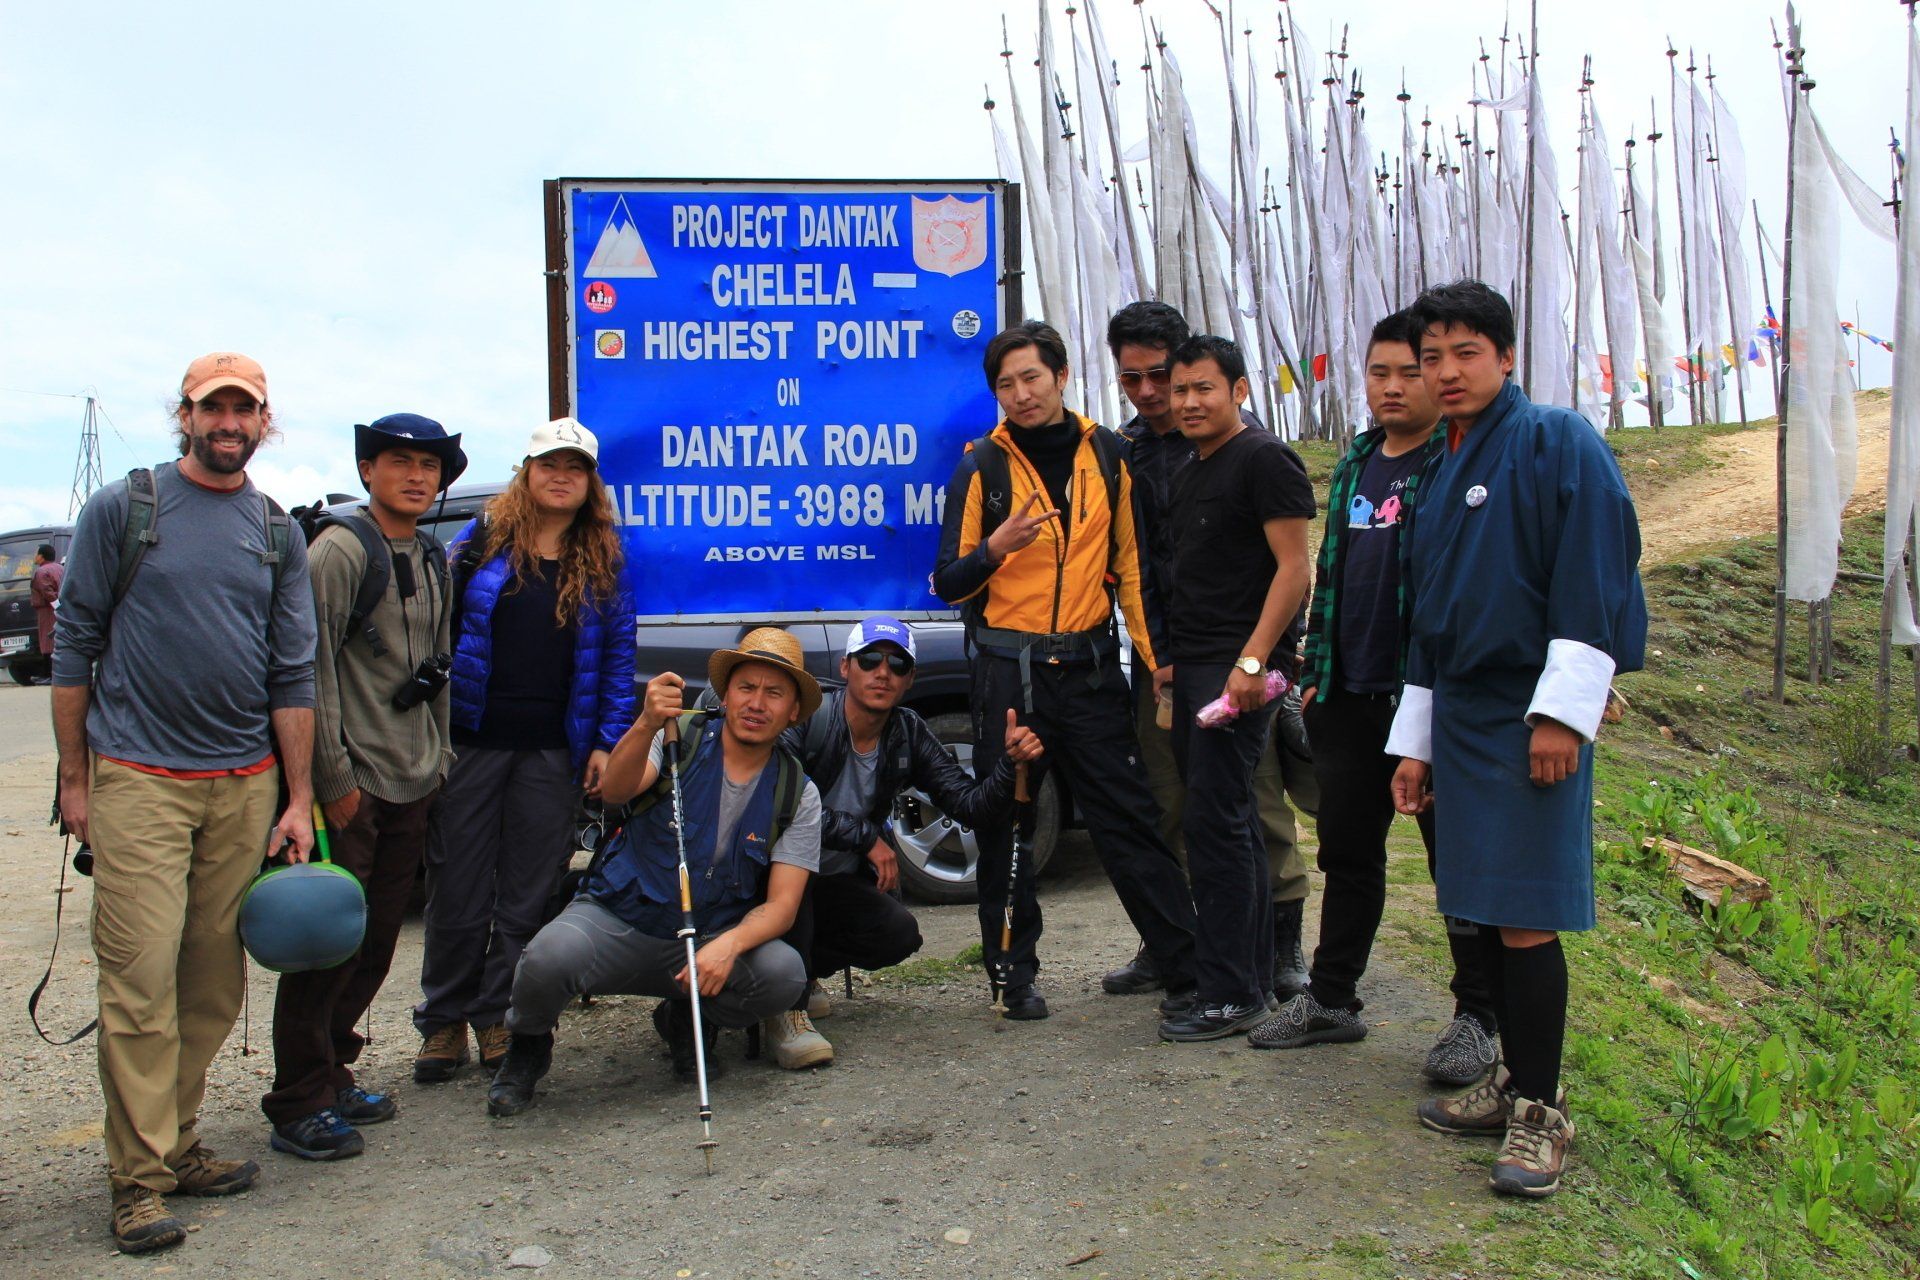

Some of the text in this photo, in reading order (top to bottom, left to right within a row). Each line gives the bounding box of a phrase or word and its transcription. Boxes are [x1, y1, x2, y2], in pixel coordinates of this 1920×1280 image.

[672, 204, 900, 249] PROJECT DANTAK
[711, 262, 857, 308] CHELELA
[644, 320, 924, 361] HIGHEST POINT
[777, 377, 800, 407] ON
[662, 423, 918, 468] DANTAK ROAD
[704, 545, 876, 562] ABOVE MSL
